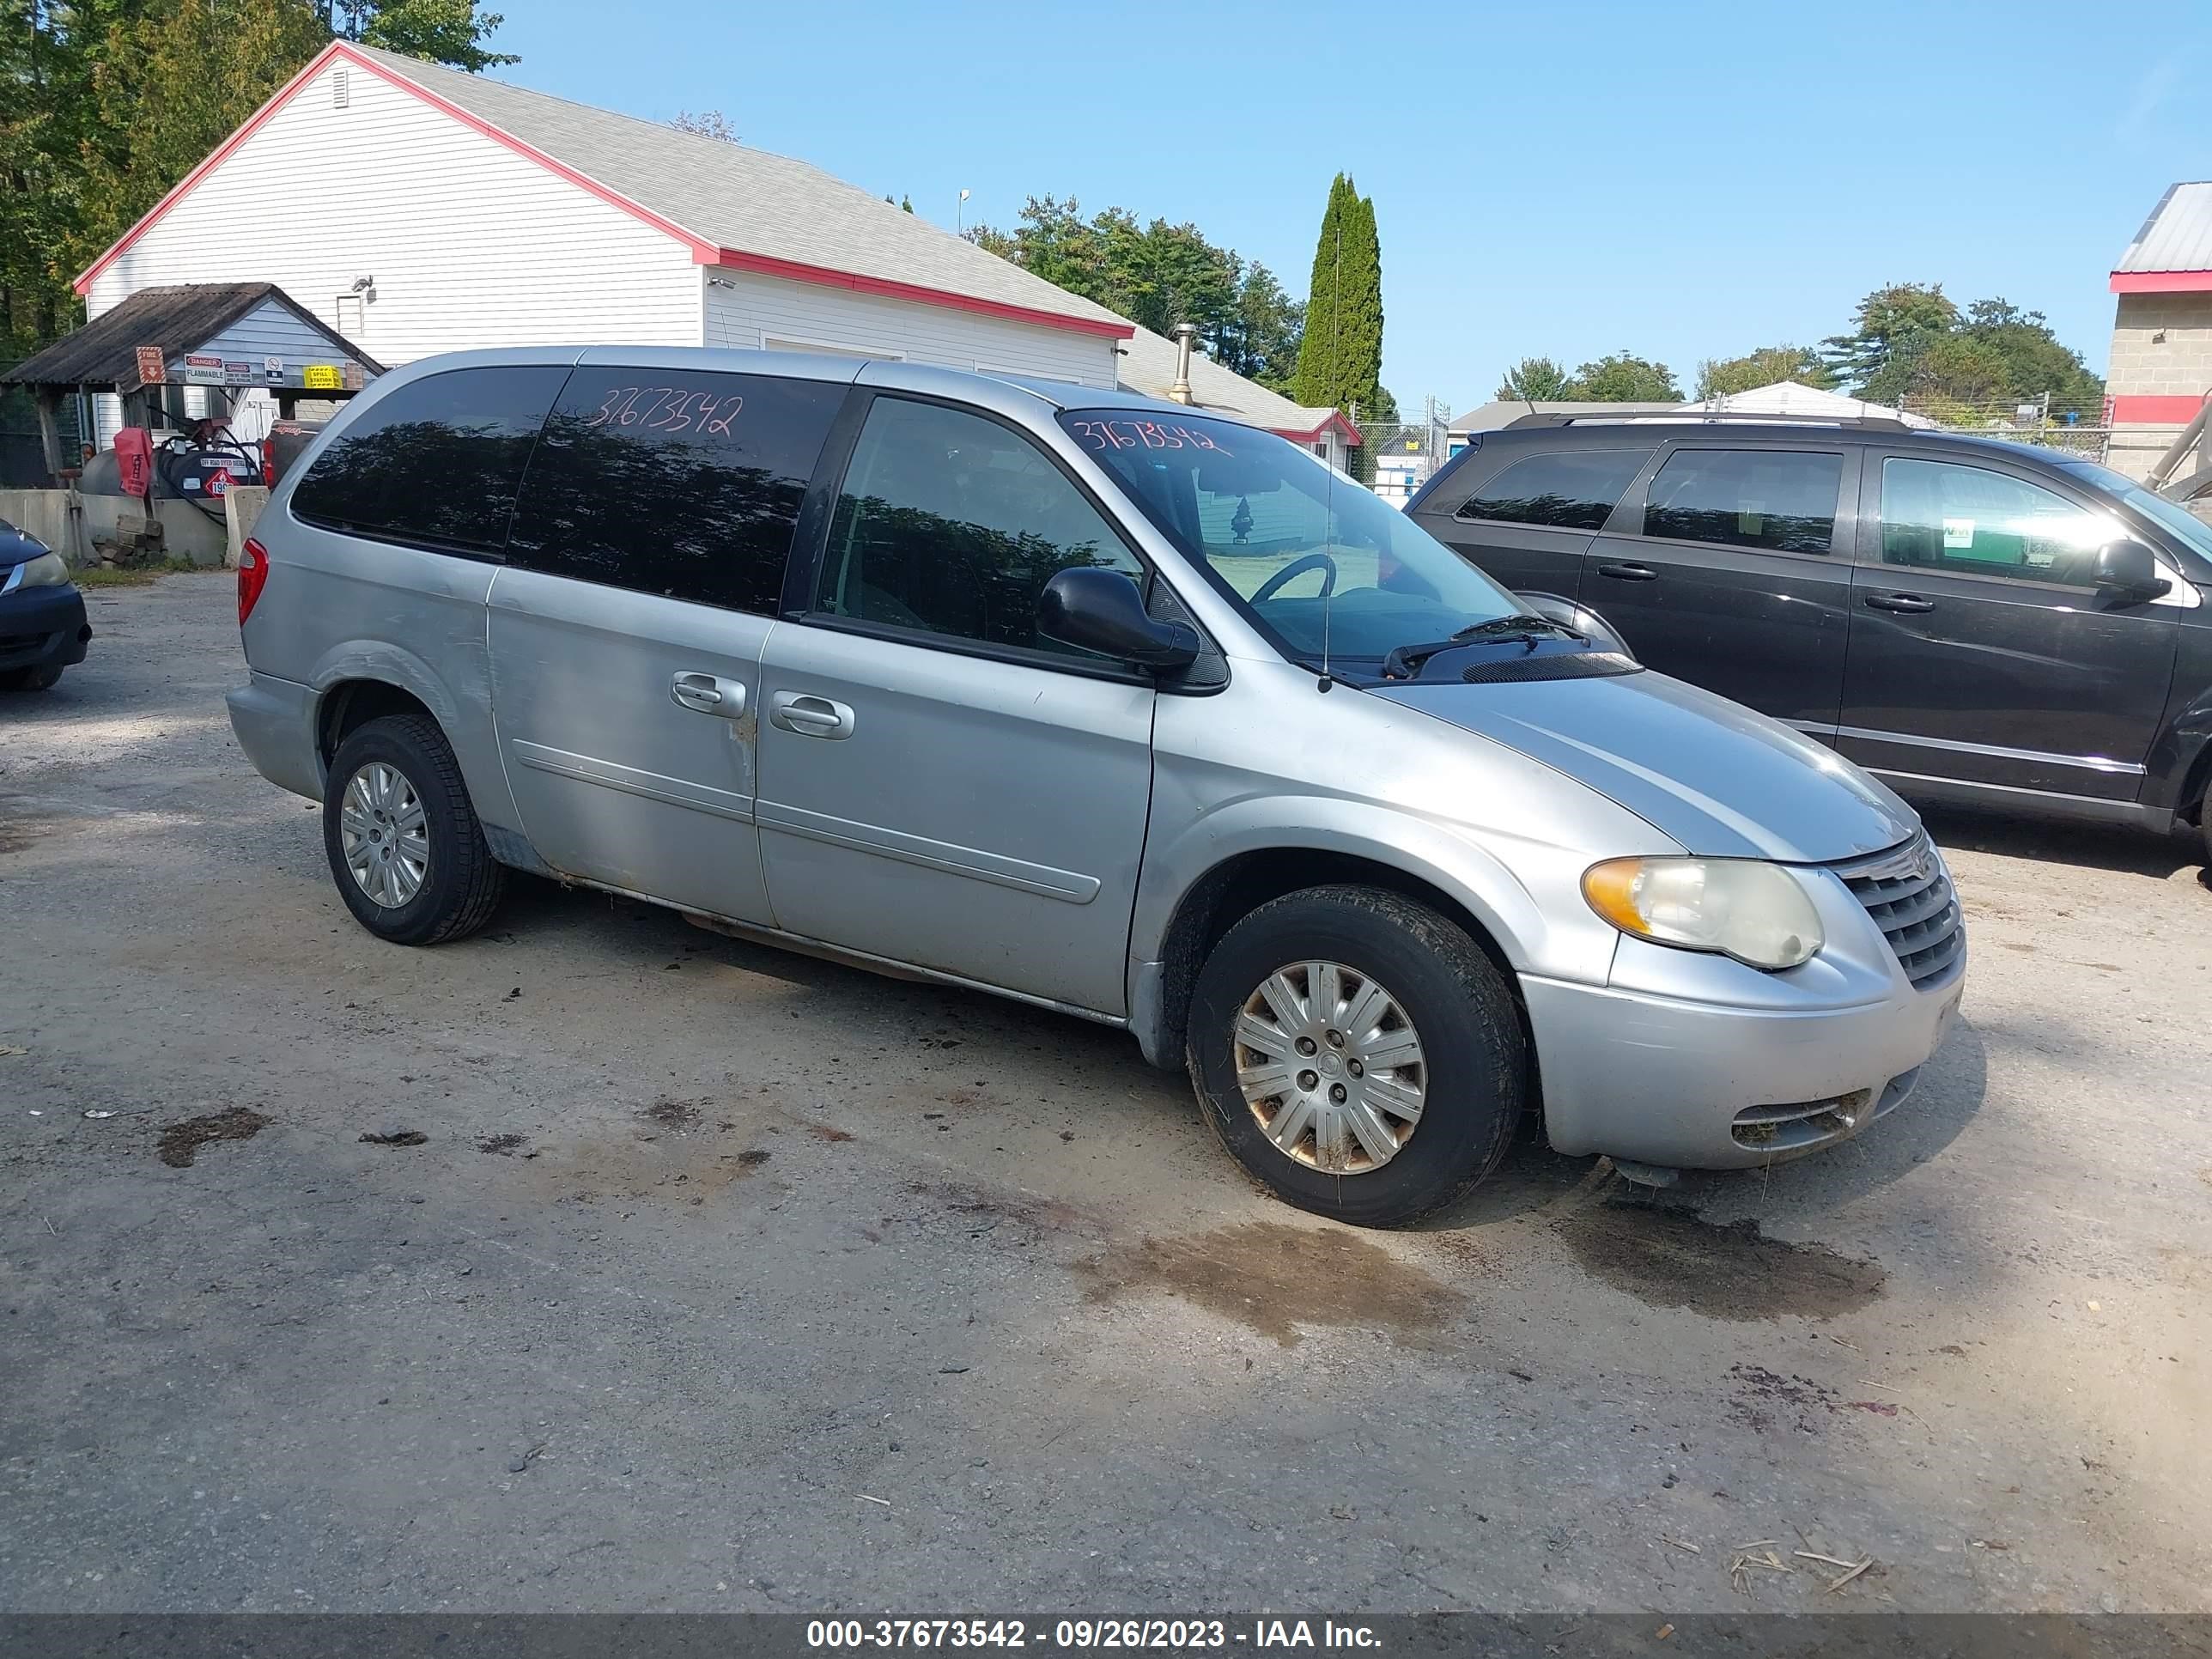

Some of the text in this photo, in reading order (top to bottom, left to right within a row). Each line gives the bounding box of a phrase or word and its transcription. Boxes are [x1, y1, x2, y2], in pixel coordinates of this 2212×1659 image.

[187, 369, 223, 379] FLAMMABLE
[586, 387, 744, 439] 37673542
[1073, 421, 1234, 458] 37673542
